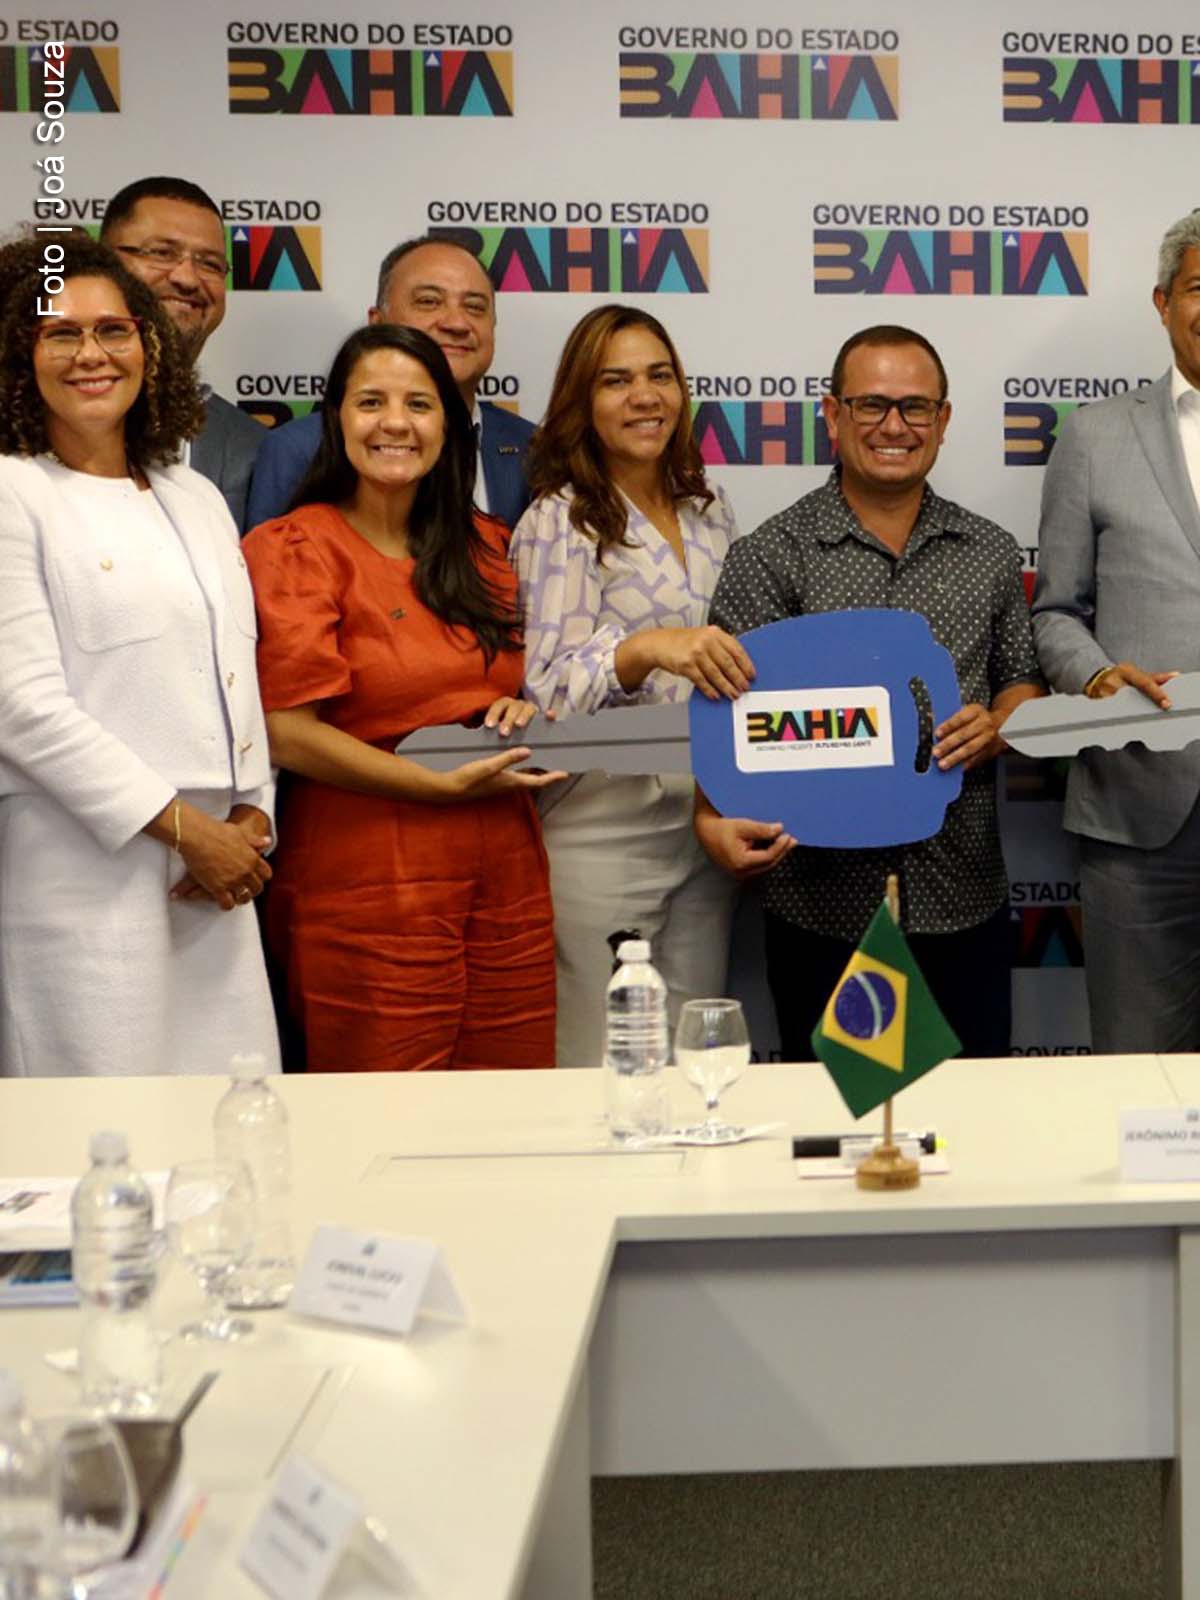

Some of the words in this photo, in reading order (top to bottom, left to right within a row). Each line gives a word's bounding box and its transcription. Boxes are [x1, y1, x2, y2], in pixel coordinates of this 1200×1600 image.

[18, 19, 119, 42] ESTADO
[227, 21, 358, 44] GOVERNO
[368, 23, 405, 45] DO
[413, 24, 513, 46] ESTADO
[618, 26, 747, 49] GOVERNO
[756, 28, 793, 49] DO
[801, 29, 899, 51] ESTADO
[1002, 31, 1128, 54] GOVERNO
[1137, 33, 1173, 55] DO
[228, 47, 514, 117] BAHIA
[619, 52, 899, 120] BAHIA
[222, 200, 321, 221] ESTADO
[428, 201, 557, 223] GOVERNO
[566, 202, 603, 224] DO
[611, 202, 709, 224] ESTADO
[813, 203, 940, 226] GOVERNO
[949, 205, 985, 227] DO
[993, 206, 1089, 228] ESTADO
[813, 228, 1089, 297] BAHIA
[236, 374, 328, 397] GOVER
[760, 376, 796, 398] DO
[746, 706, 878, 743] BAHIA
